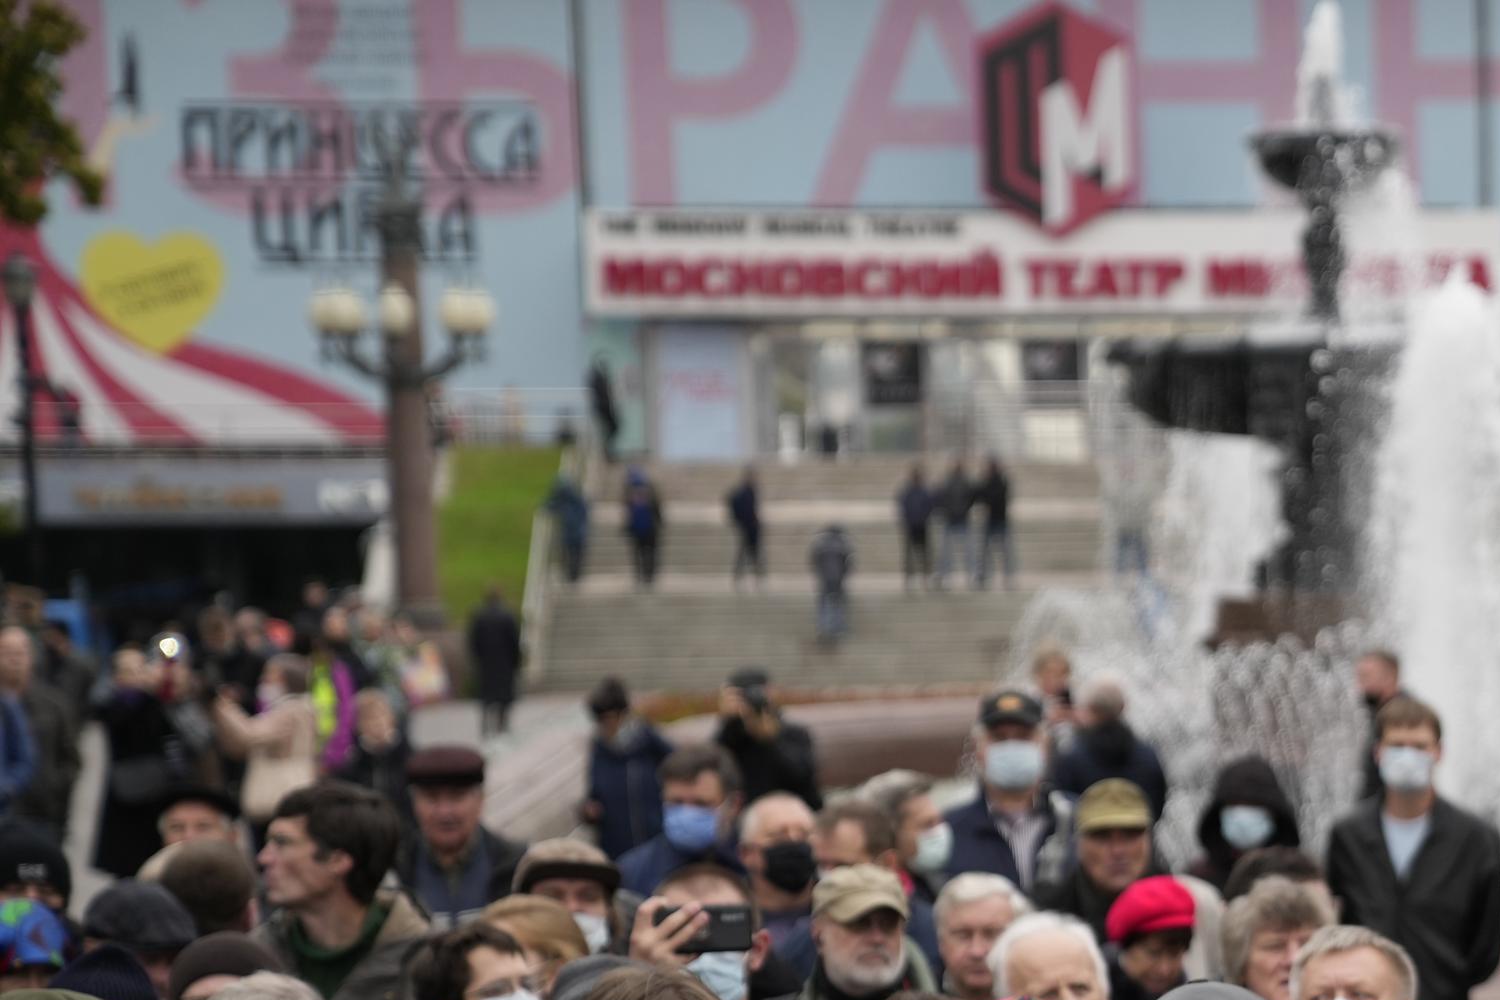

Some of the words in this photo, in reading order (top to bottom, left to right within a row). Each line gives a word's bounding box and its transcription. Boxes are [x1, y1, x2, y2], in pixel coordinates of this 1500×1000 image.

[250, 186, 478, 265] ЦИРА
[605, 245, 1001, 297] МОСКОВСКИЙ
[1026, 256, 1186, 298] ТЕАТР
